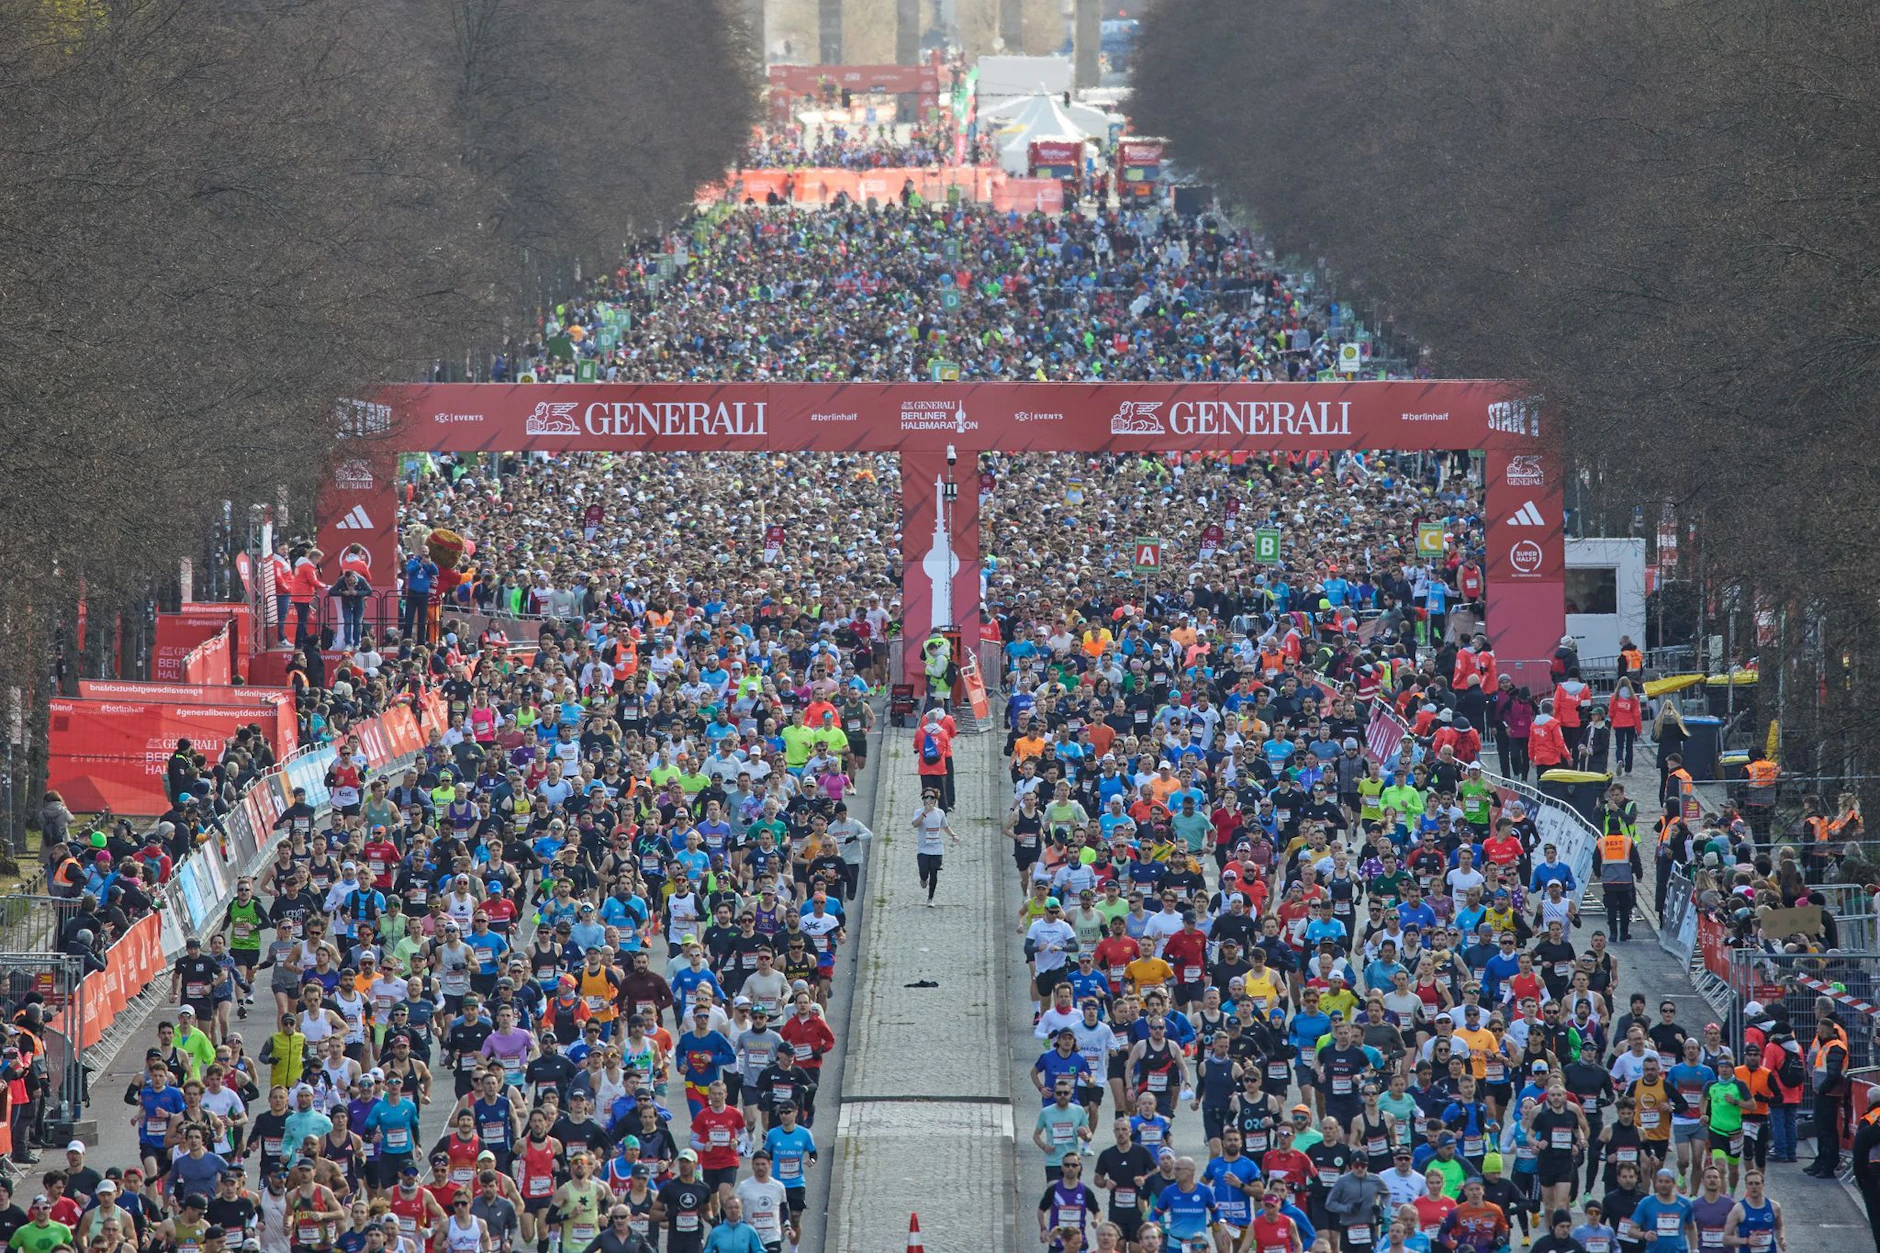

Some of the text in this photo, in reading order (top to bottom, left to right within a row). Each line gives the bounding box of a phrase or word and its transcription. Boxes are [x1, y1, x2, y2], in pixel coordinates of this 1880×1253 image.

[913, 401, 956, 410] GENERALI
[584, 402, 768, 436] GENERALI
[811, 412, 858, 422] #berlinhalf
[901, 412, 947, 420] BERLINER
[1168, 401, 1352, 436] GENERALI
[1401, 412, 1450, 422] #berlinhalf
[1488, 397, 1543, 437] START
[1507, 477, 1544, 486] GENERALI
[1202, 540, 1217, 549] 1:35
[1423, 531, 1438, 550] C
[1260, 537, 1275, 556] B
[1139, 546, 1155, 565] A
[101, 703, 144, 713] #berlinhalf
